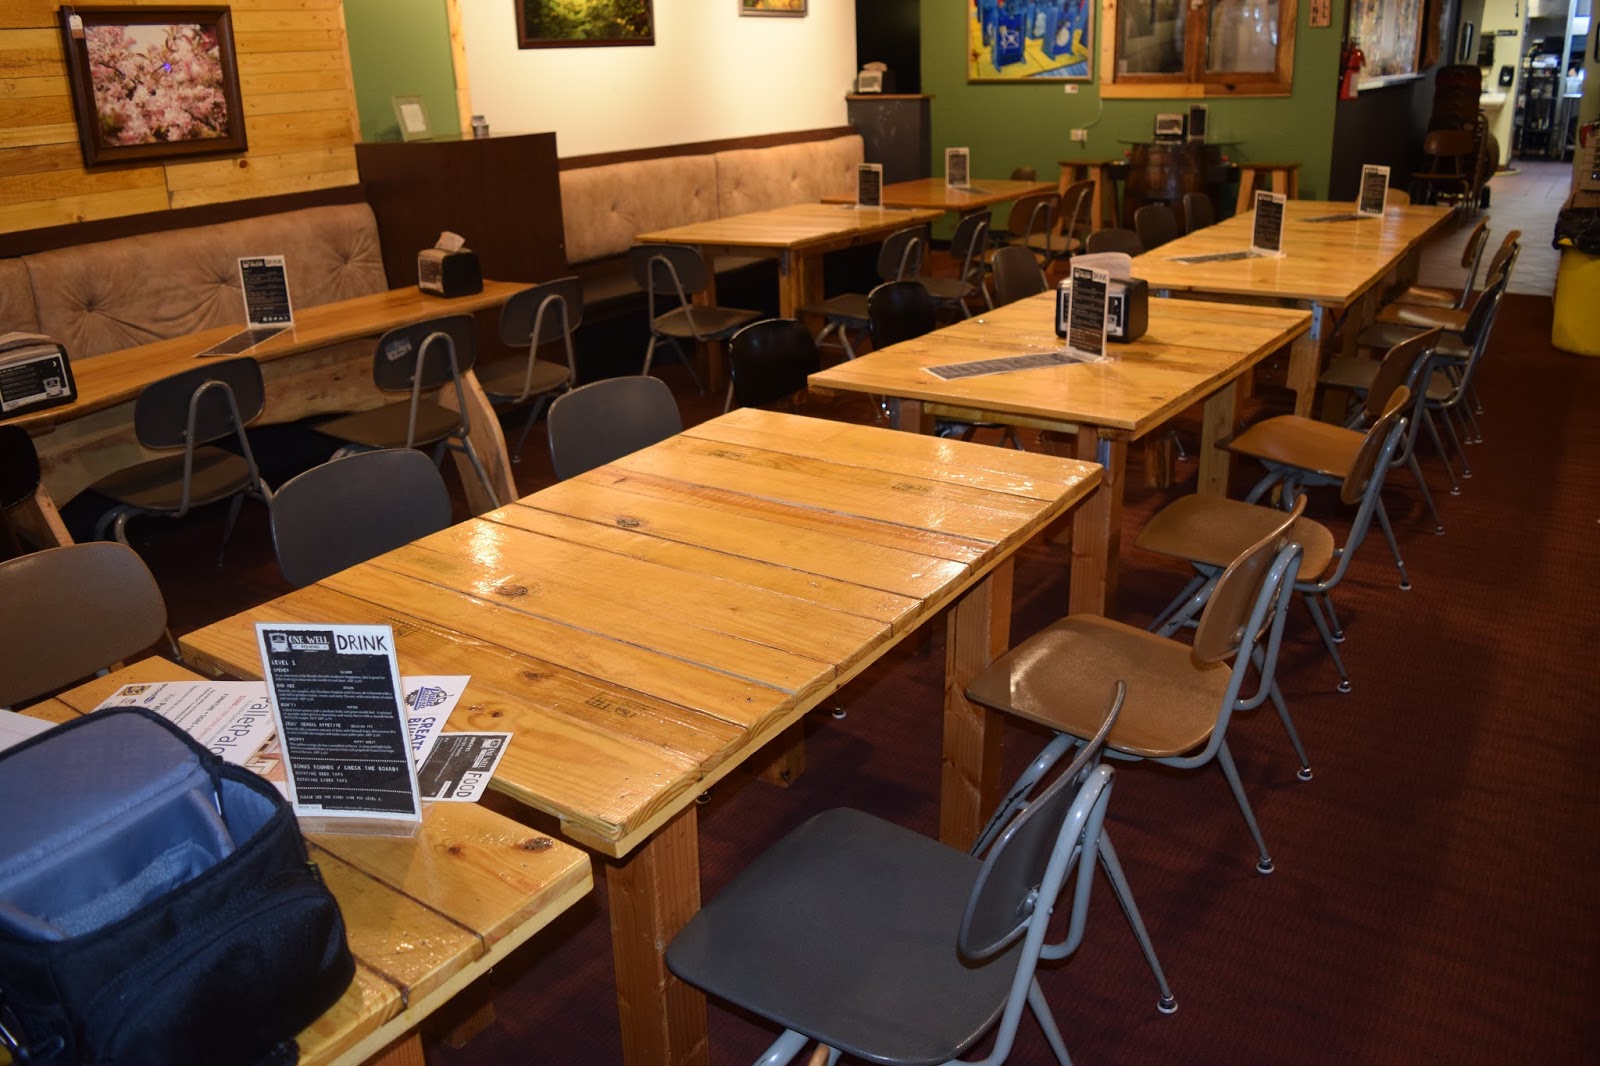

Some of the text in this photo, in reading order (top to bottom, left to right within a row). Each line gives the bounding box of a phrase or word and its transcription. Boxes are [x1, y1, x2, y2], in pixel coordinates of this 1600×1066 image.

[288, 635, 330, 644] ONE WELL
[336, 634, 388, 651] DRINK
[456, 772, 482, 798] FOOD
